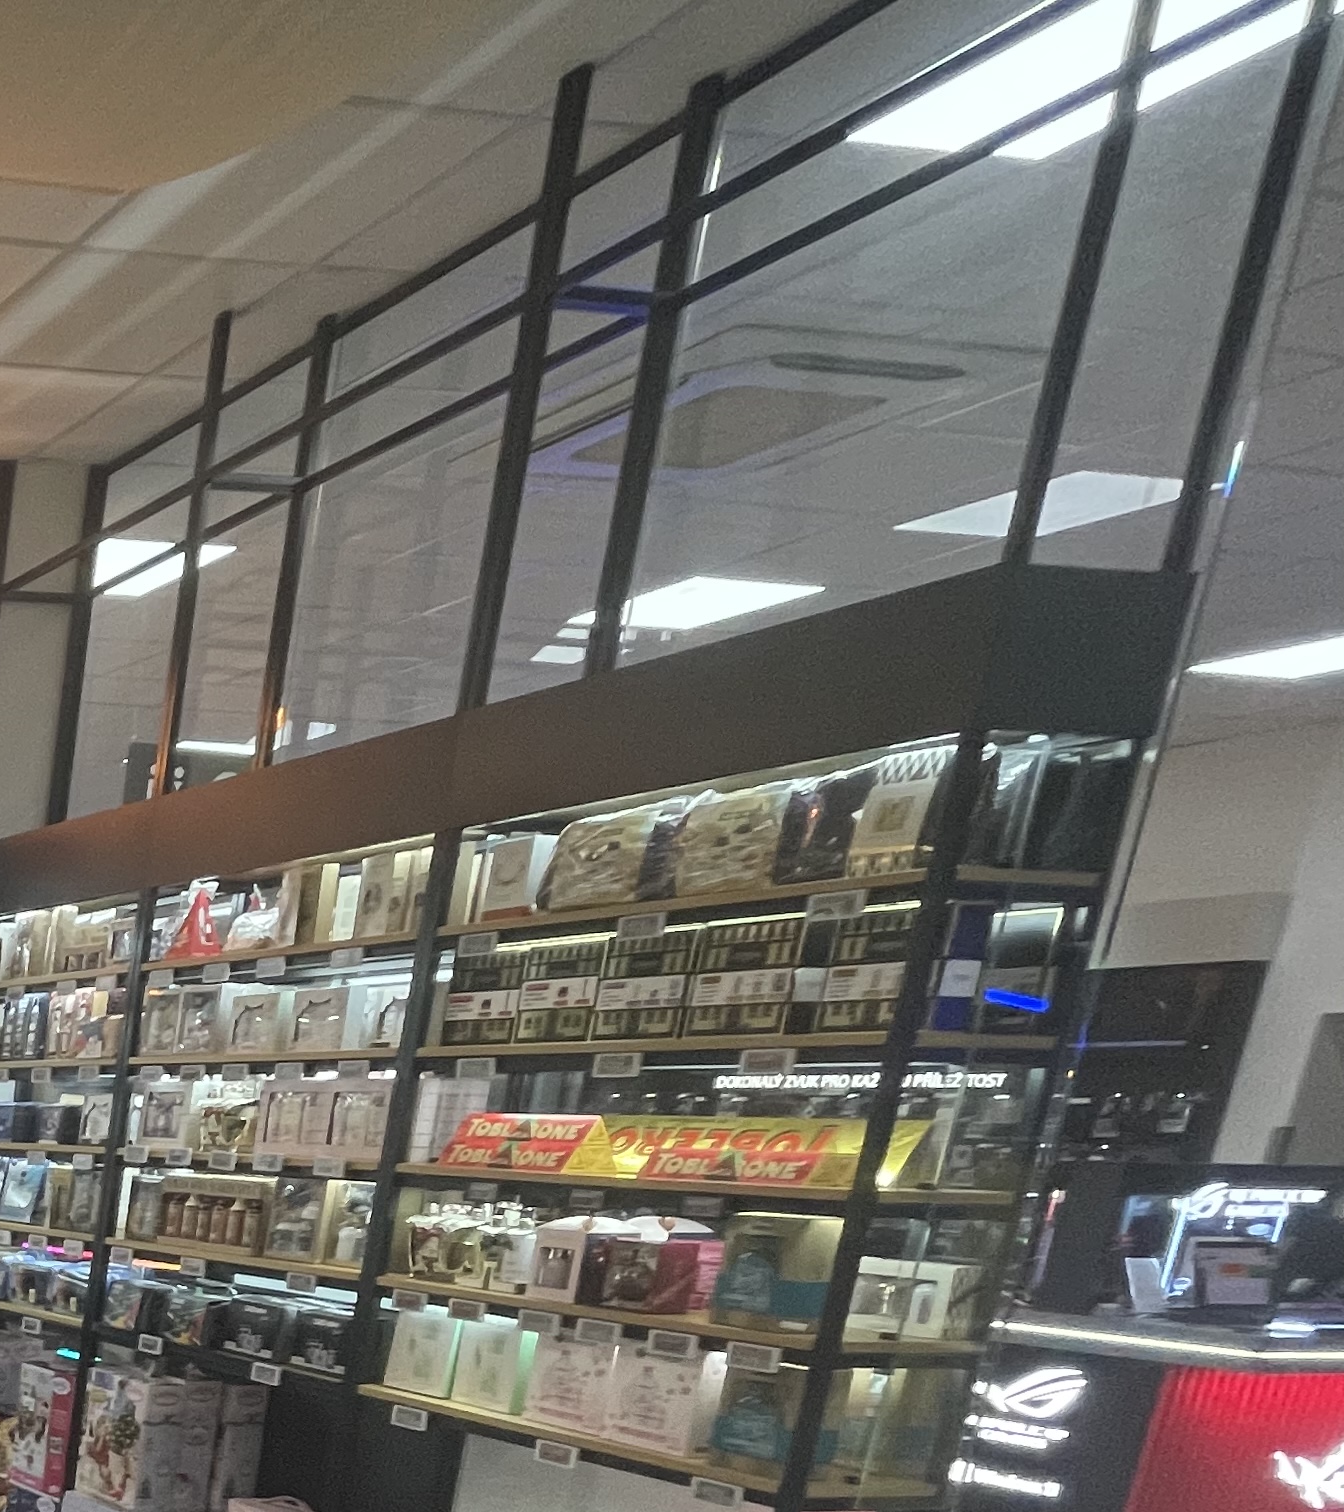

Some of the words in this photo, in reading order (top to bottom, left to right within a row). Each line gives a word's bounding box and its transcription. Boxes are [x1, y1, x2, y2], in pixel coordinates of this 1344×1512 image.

[784, 1073, 819, 1088] ZVUK
[820, 1073, 850, 1088] PRO
[912, 1071, 1008, 1089] PŘÍLEŽTOST
[465, 1118, 590, 1141] TOBLRONE
[447, 1144, 567, 1168] TOBLRONE
[652, 1153, 807, 1180] TOBLRONE
